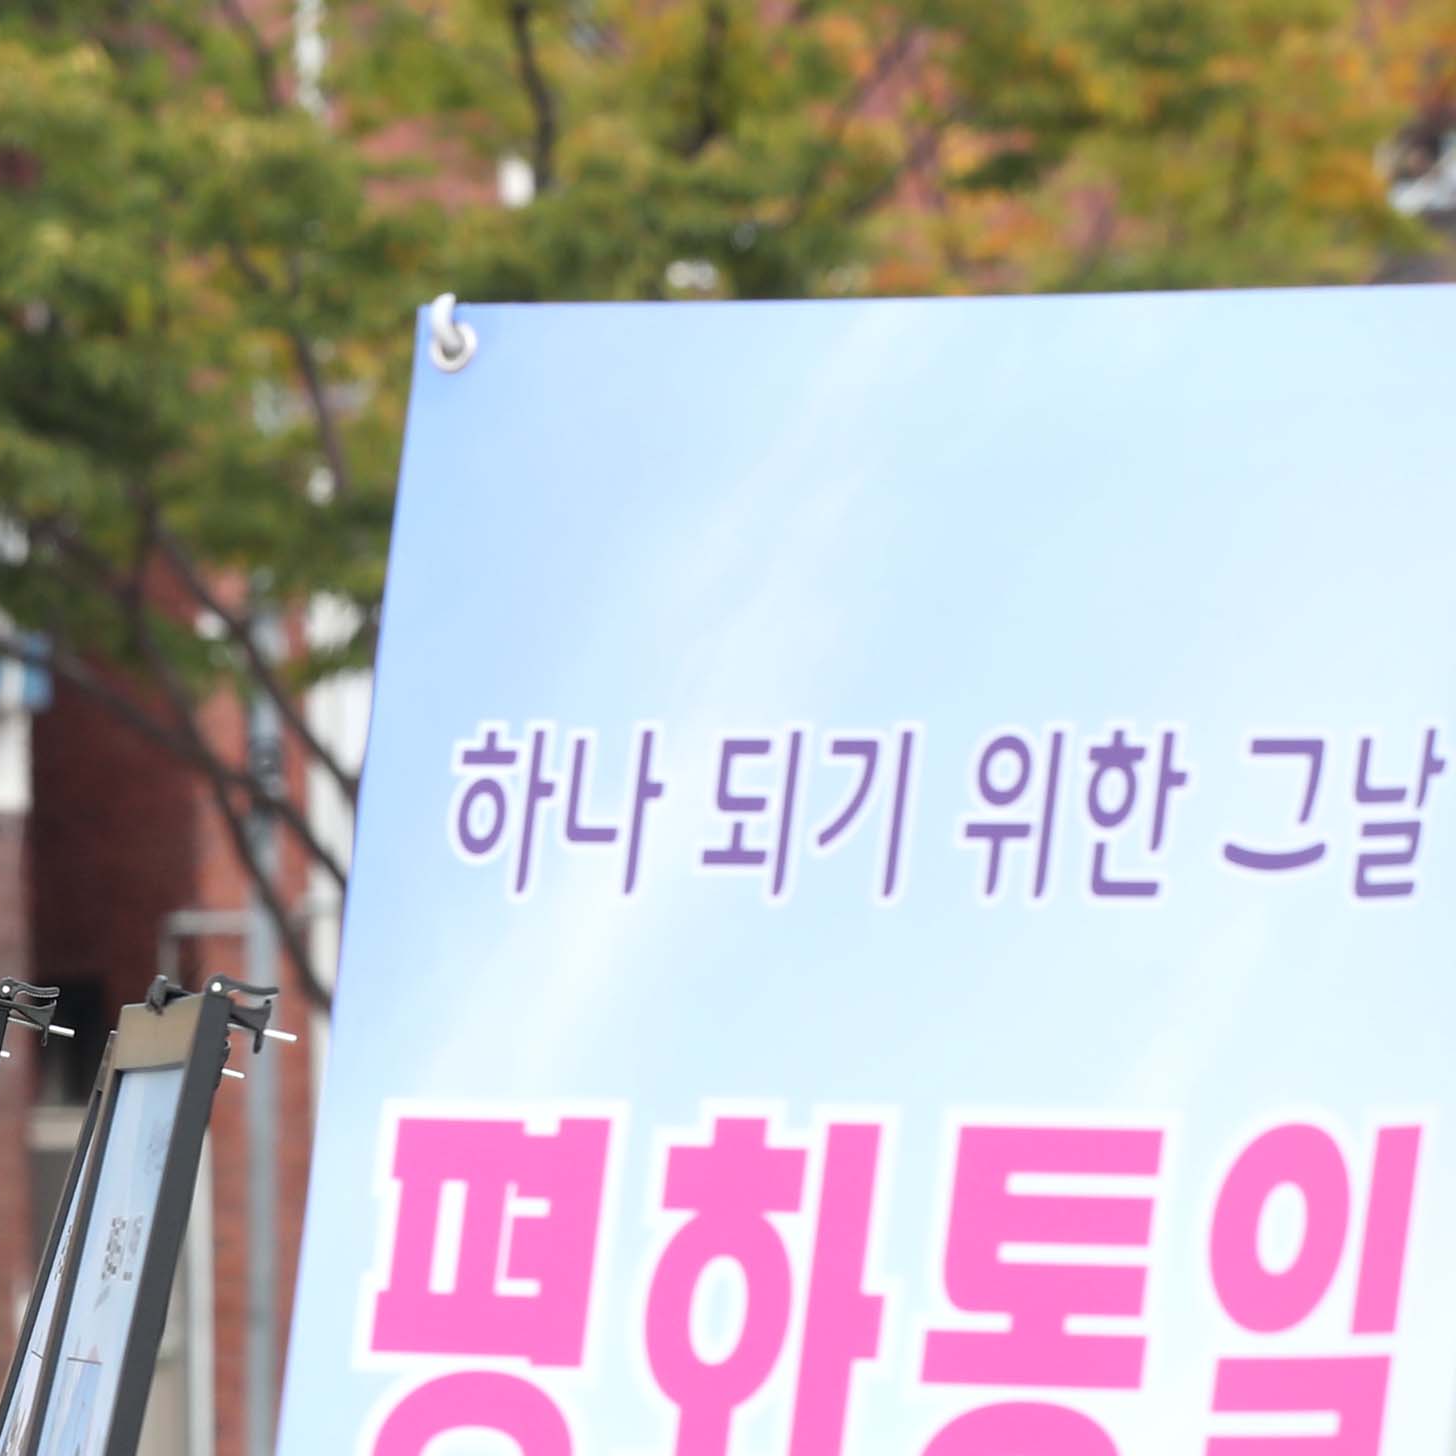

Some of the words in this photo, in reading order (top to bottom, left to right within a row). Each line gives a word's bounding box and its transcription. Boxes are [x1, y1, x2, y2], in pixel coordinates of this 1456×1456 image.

[457, 730, 664, 896] 하나
[701, 730, 915, 898] 되기
[964, 730, 1188, 899] 위한
[1222, 728, 1446, 899] 그날
